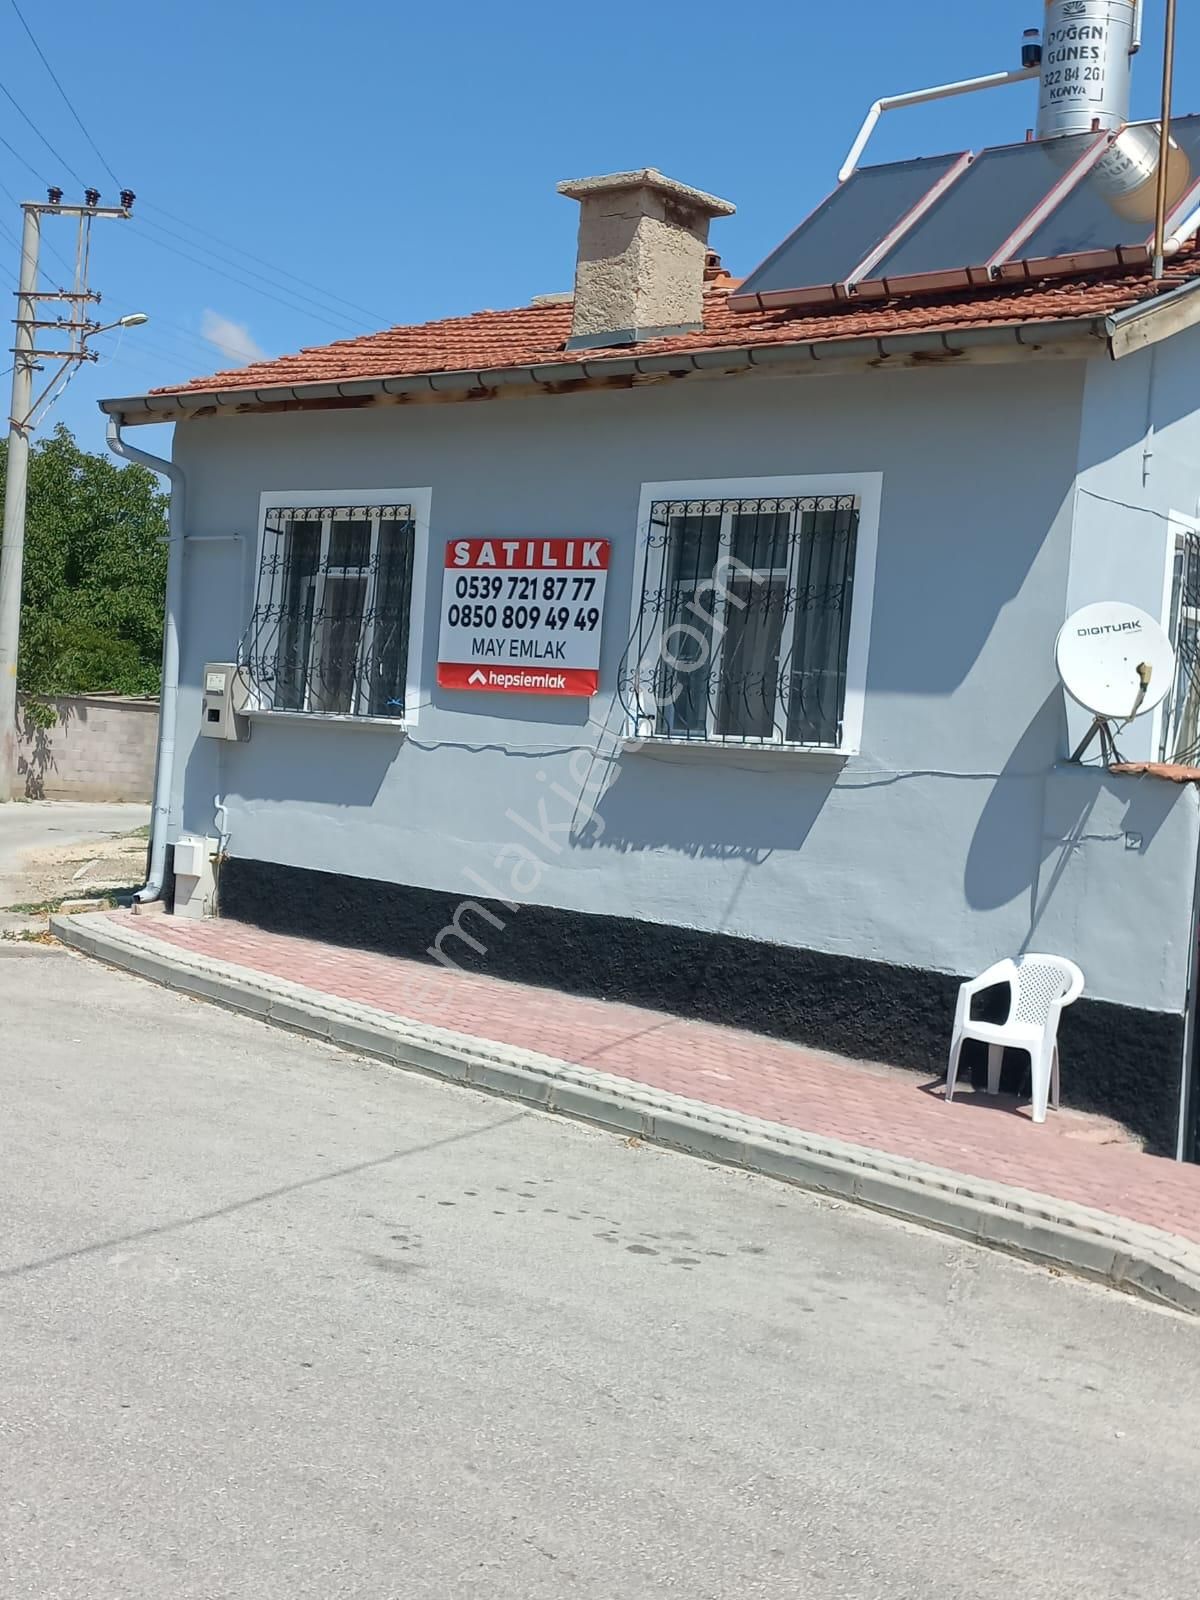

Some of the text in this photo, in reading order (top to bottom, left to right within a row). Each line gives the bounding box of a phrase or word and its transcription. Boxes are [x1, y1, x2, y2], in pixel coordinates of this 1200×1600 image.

[1048, 24, 1103, 46] DOĞAN
[1048, 45, 1100, 64] GÜNEŞ
[1049, 85, 1087, 99] KONYA
[453, 541, 603, 567] SATILIK
[455, 575, 596, 601] 0539 721 87 77
[448, 604, 600, 631] 0850 809 49 49
[1077, 620, 1141, 637] DIGITURK
[471, 637, 567, 659] MAY EMLAK
[488, 671, 566, 689] hepsiemlak
